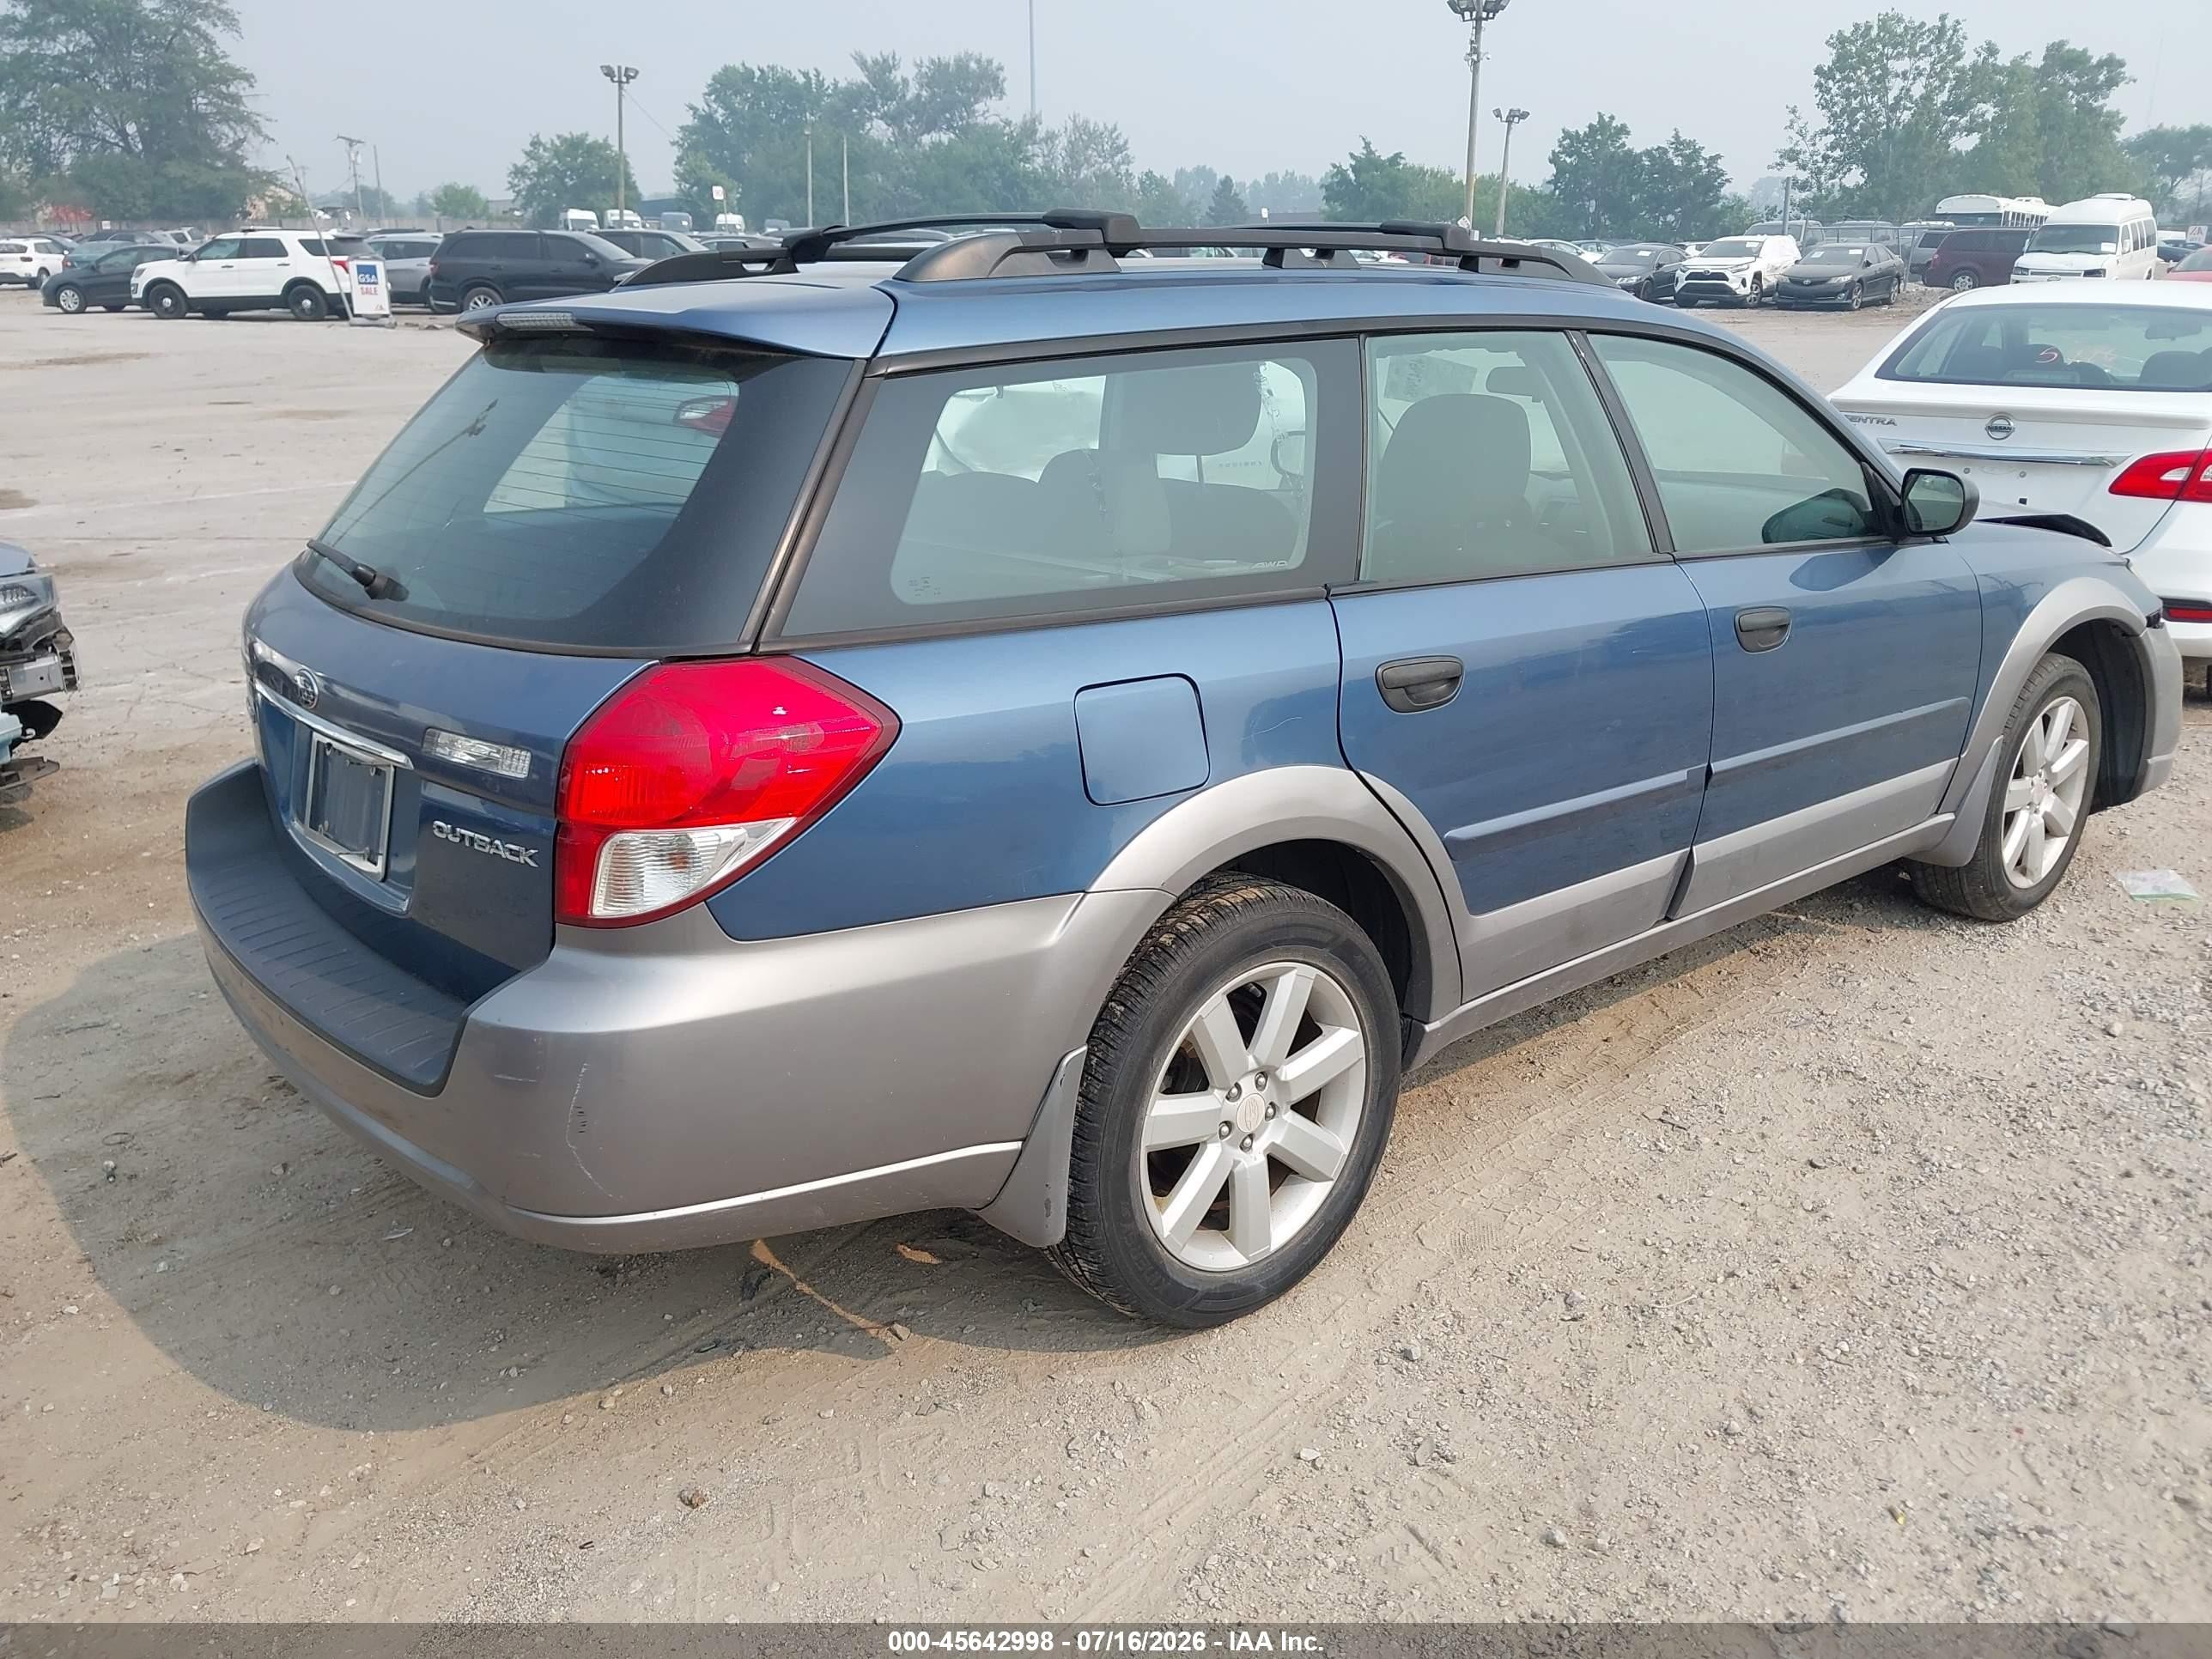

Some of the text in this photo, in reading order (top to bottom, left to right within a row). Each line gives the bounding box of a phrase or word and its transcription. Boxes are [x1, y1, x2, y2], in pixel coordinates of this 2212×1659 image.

[358, 273, 378, 283] GSA
[361, 287, 379, 295] SALE
[432, 820, 539, 867] OUTBACK
